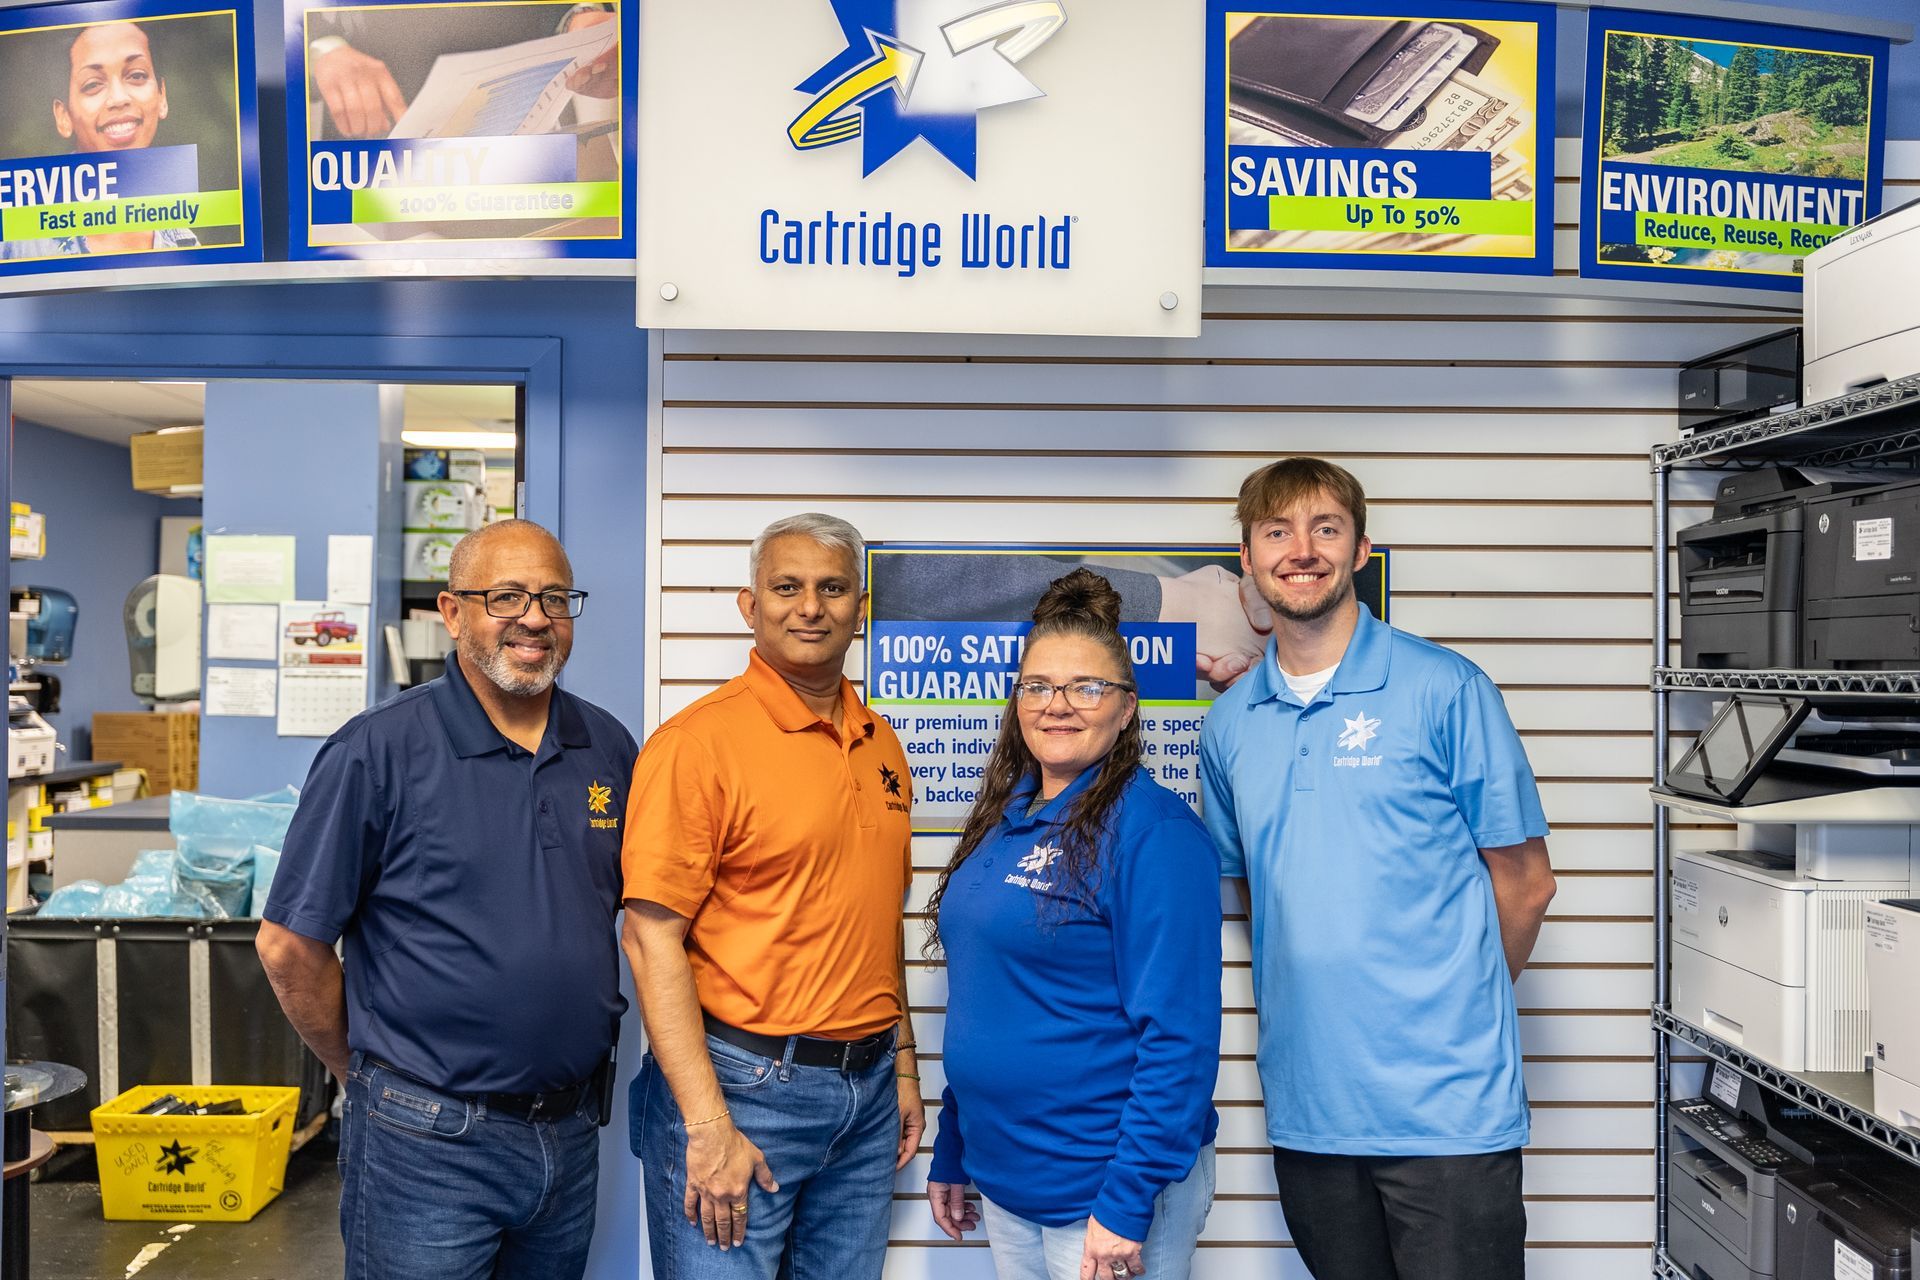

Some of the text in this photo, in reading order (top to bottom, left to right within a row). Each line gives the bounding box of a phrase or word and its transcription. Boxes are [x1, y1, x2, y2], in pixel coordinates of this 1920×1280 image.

[312, 147, 489, 191] QUALITY
[1230, 156, 1417, 199] SAVINGS
[0, 162, 119, 208] ERVICE
[1602, 171, 1863, 227] ENVIRONMENT
[39, 200, 199, 230] Fast and Friendly
[400, 191, 574, 213] 100% Guarantee
[1346, 204, 1460, 229] Up To 50%
[760, 209, 941, 277] Cartridge
[1644, 218, 1717, 244] Reduce,
[1724, 222, 1783, 249] Reuse,
[878, 635, 952, 664] 100%
[878, 671, 1020, 699] GUARANT
[916, 714, 988, 734] premium
[1141, 718, 1156, 731] re
[1162, 715, 1205, 735] speci
[906, 739, 945, 754] each
[952, 738, 997, 754] indivi
[910, 765, 947, 782] very
[952, 762, 985, 778] lase
[1162, 763, 1189, 779] the
[148, 1181, 206, 1194] Cartridge World
